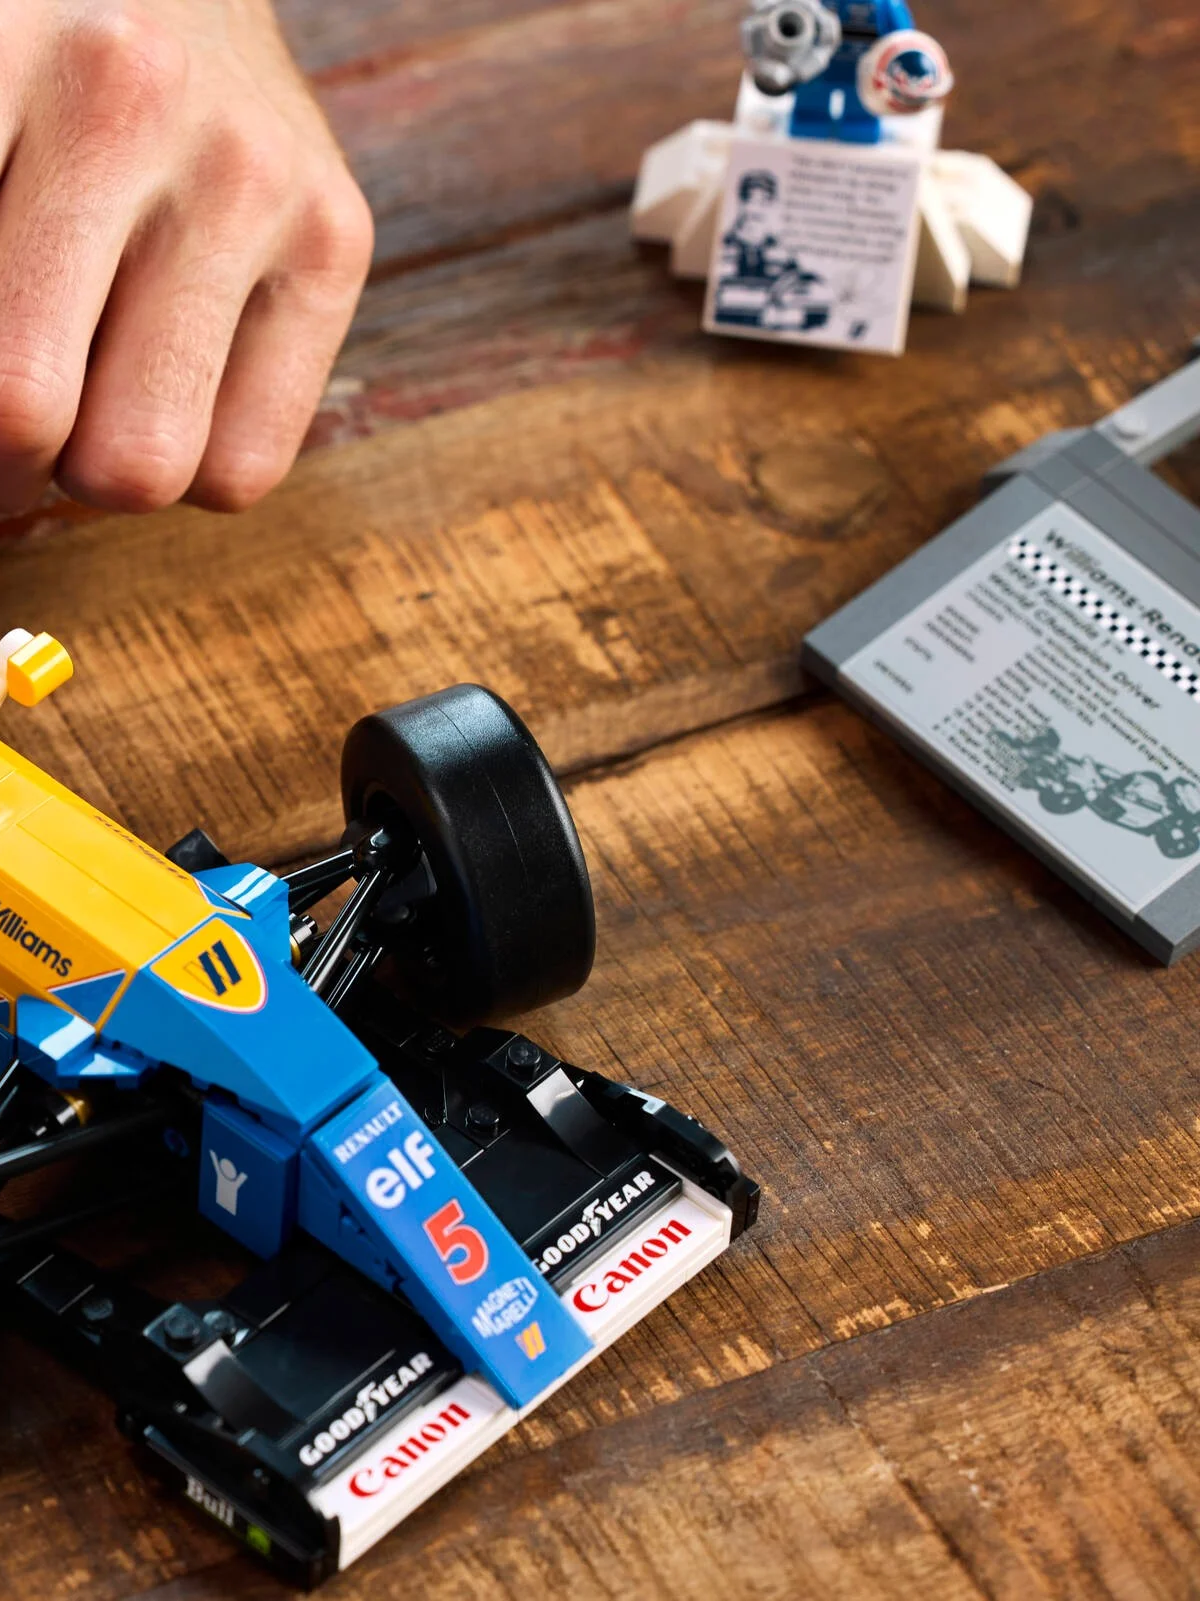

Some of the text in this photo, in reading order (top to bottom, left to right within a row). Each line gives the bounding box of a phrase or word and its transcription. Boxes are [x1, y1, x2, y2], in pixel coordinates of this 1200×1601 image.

[1046, 529, 1200, 666] Williams-Rena
[1112, 669, 1161, 712] Driver
[333, 1100, 404, 1165] RENAULT
[365, 1130, 437, 1209] elf
[422, 1198, 489, 1286] 5
[573, 1219, 693, 1312] Canon
[298, 1352, 434, 1466] GOODYEAR
[349, 1402, 471, 1497] Canon
[186, 1474, 235, 1528] Bull
